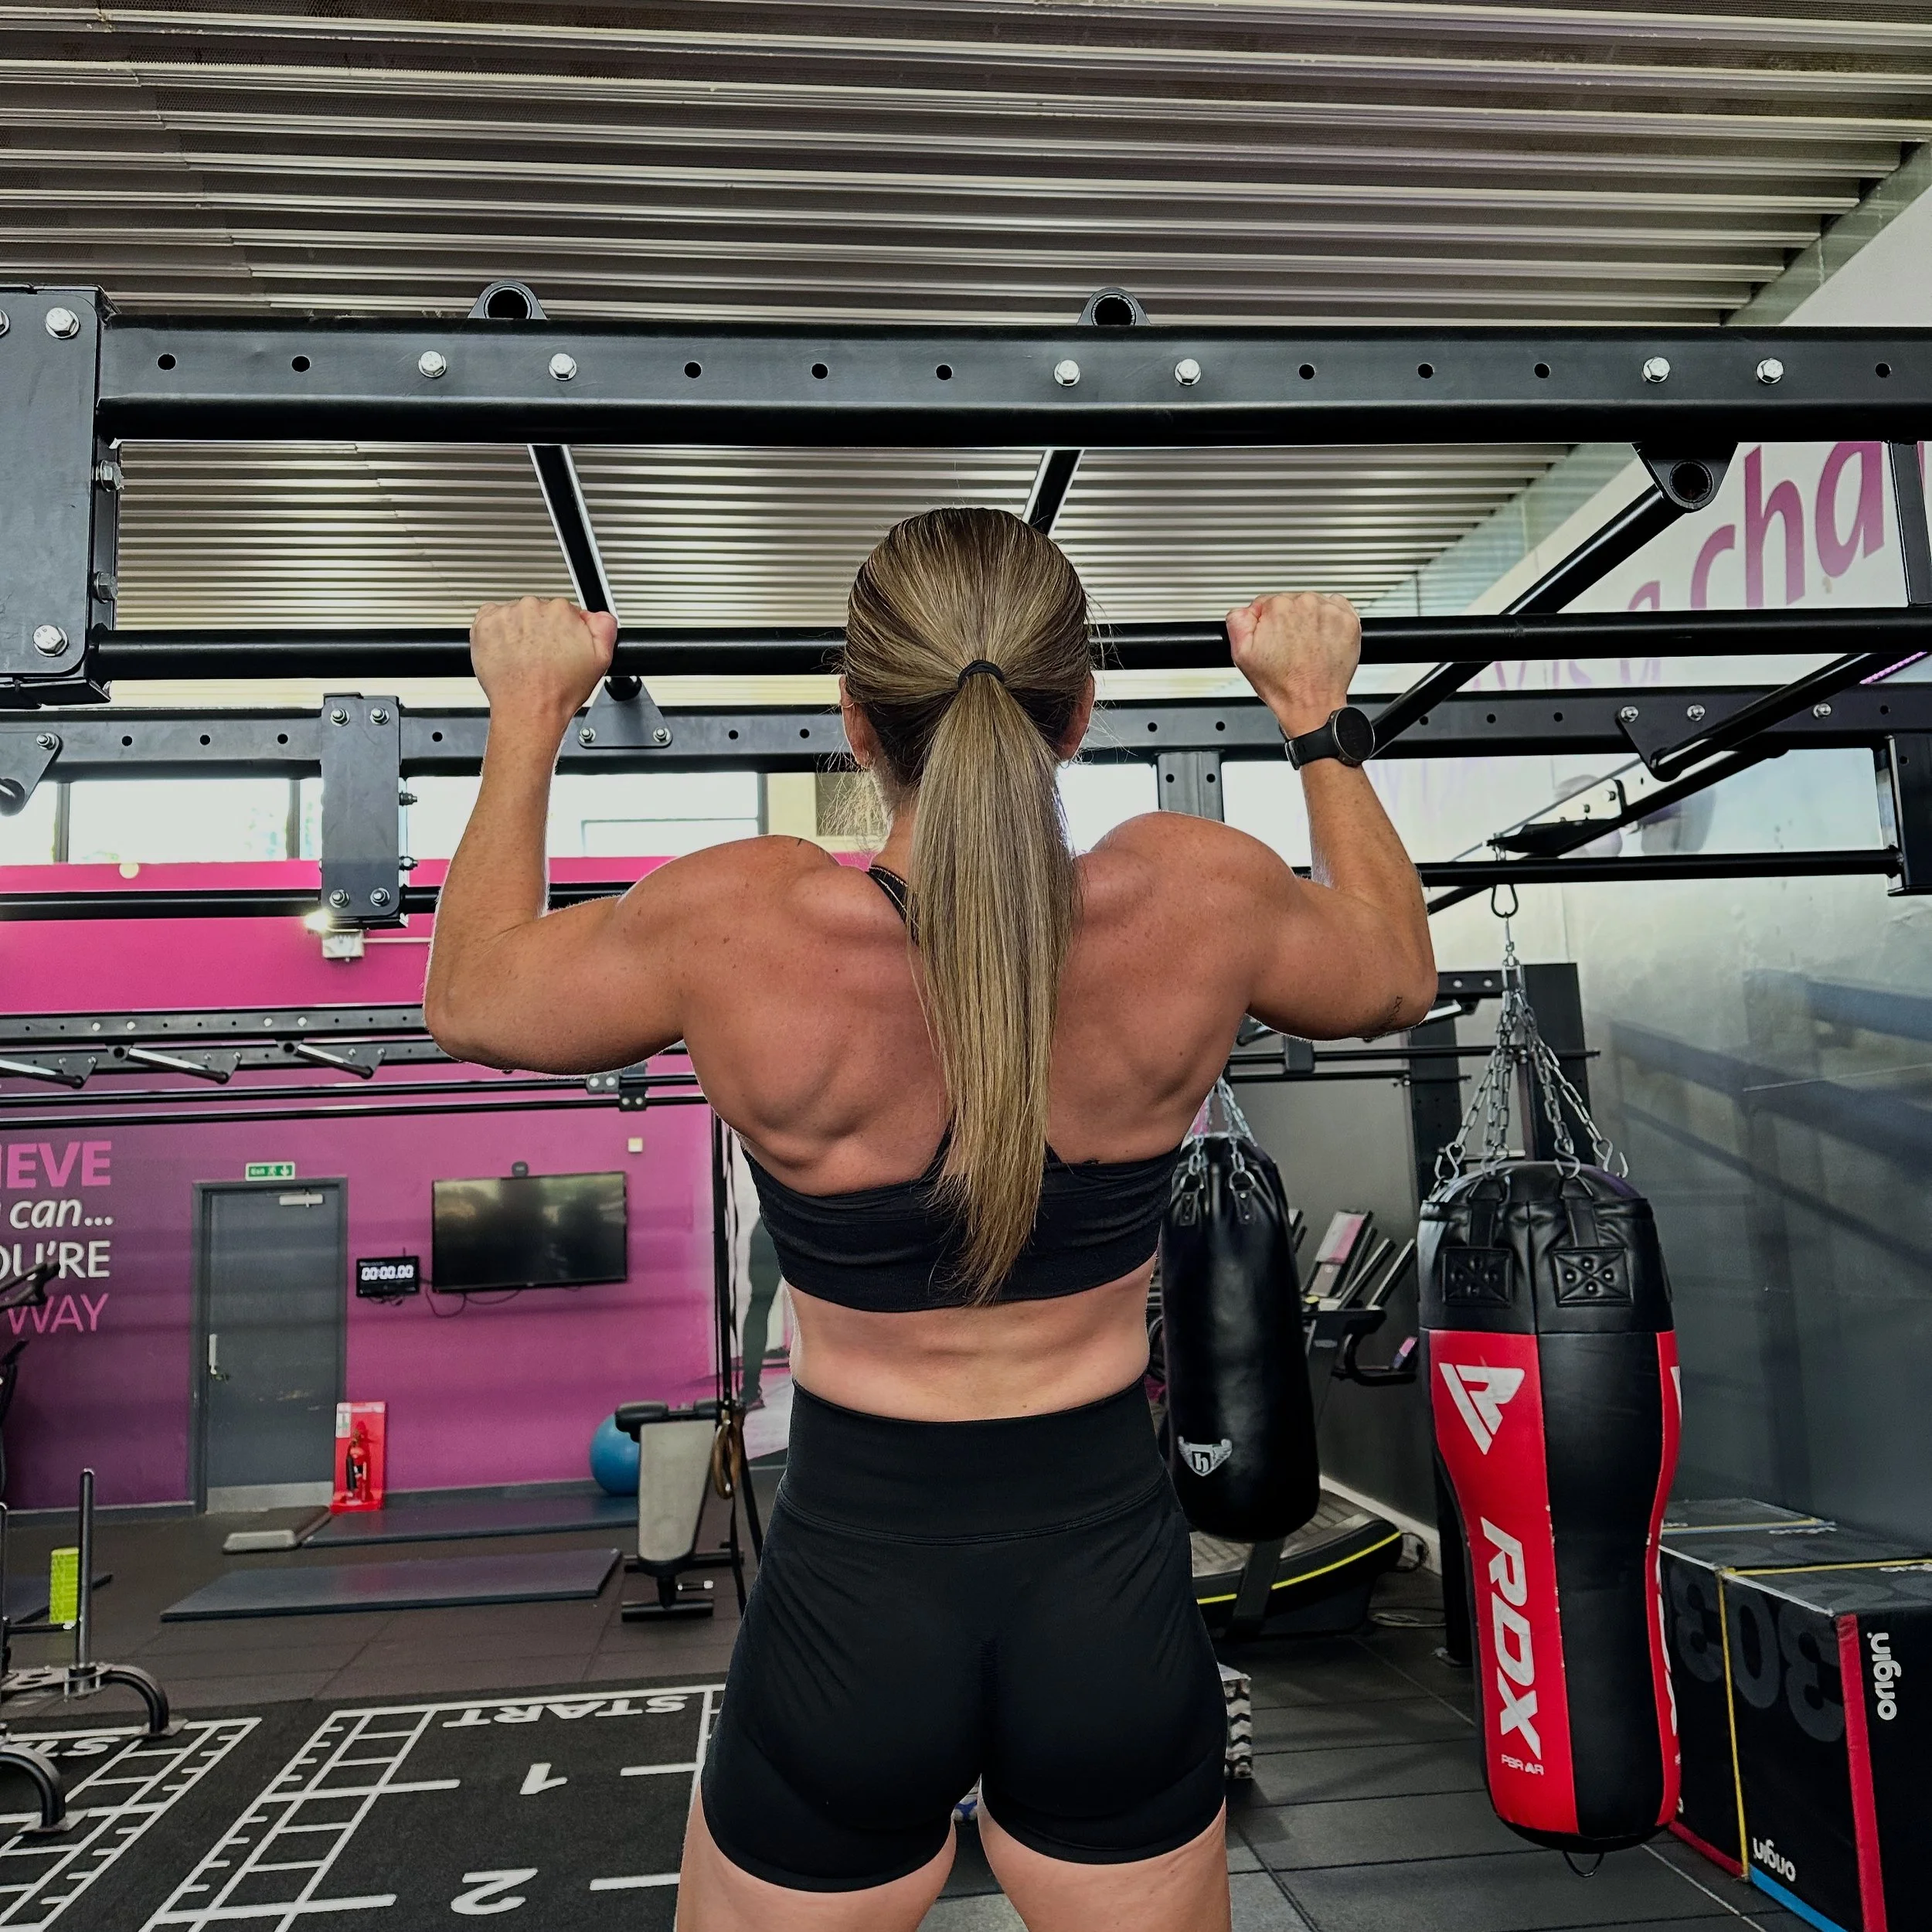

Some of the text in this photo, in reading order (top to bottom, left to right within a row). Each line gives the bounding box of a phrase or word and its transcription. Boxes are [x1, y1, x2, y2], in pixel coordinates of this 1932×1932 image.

[1691, 441, 1927, 609] cha
[1480, 1516, 1542, 1760] RDX
[1866, 1631, 1902, 1721] origin
[442, 1695, 689, 1728] START
[519, 1762, 568, 1795] 1
[451, 1867, 539, 1915] 2
